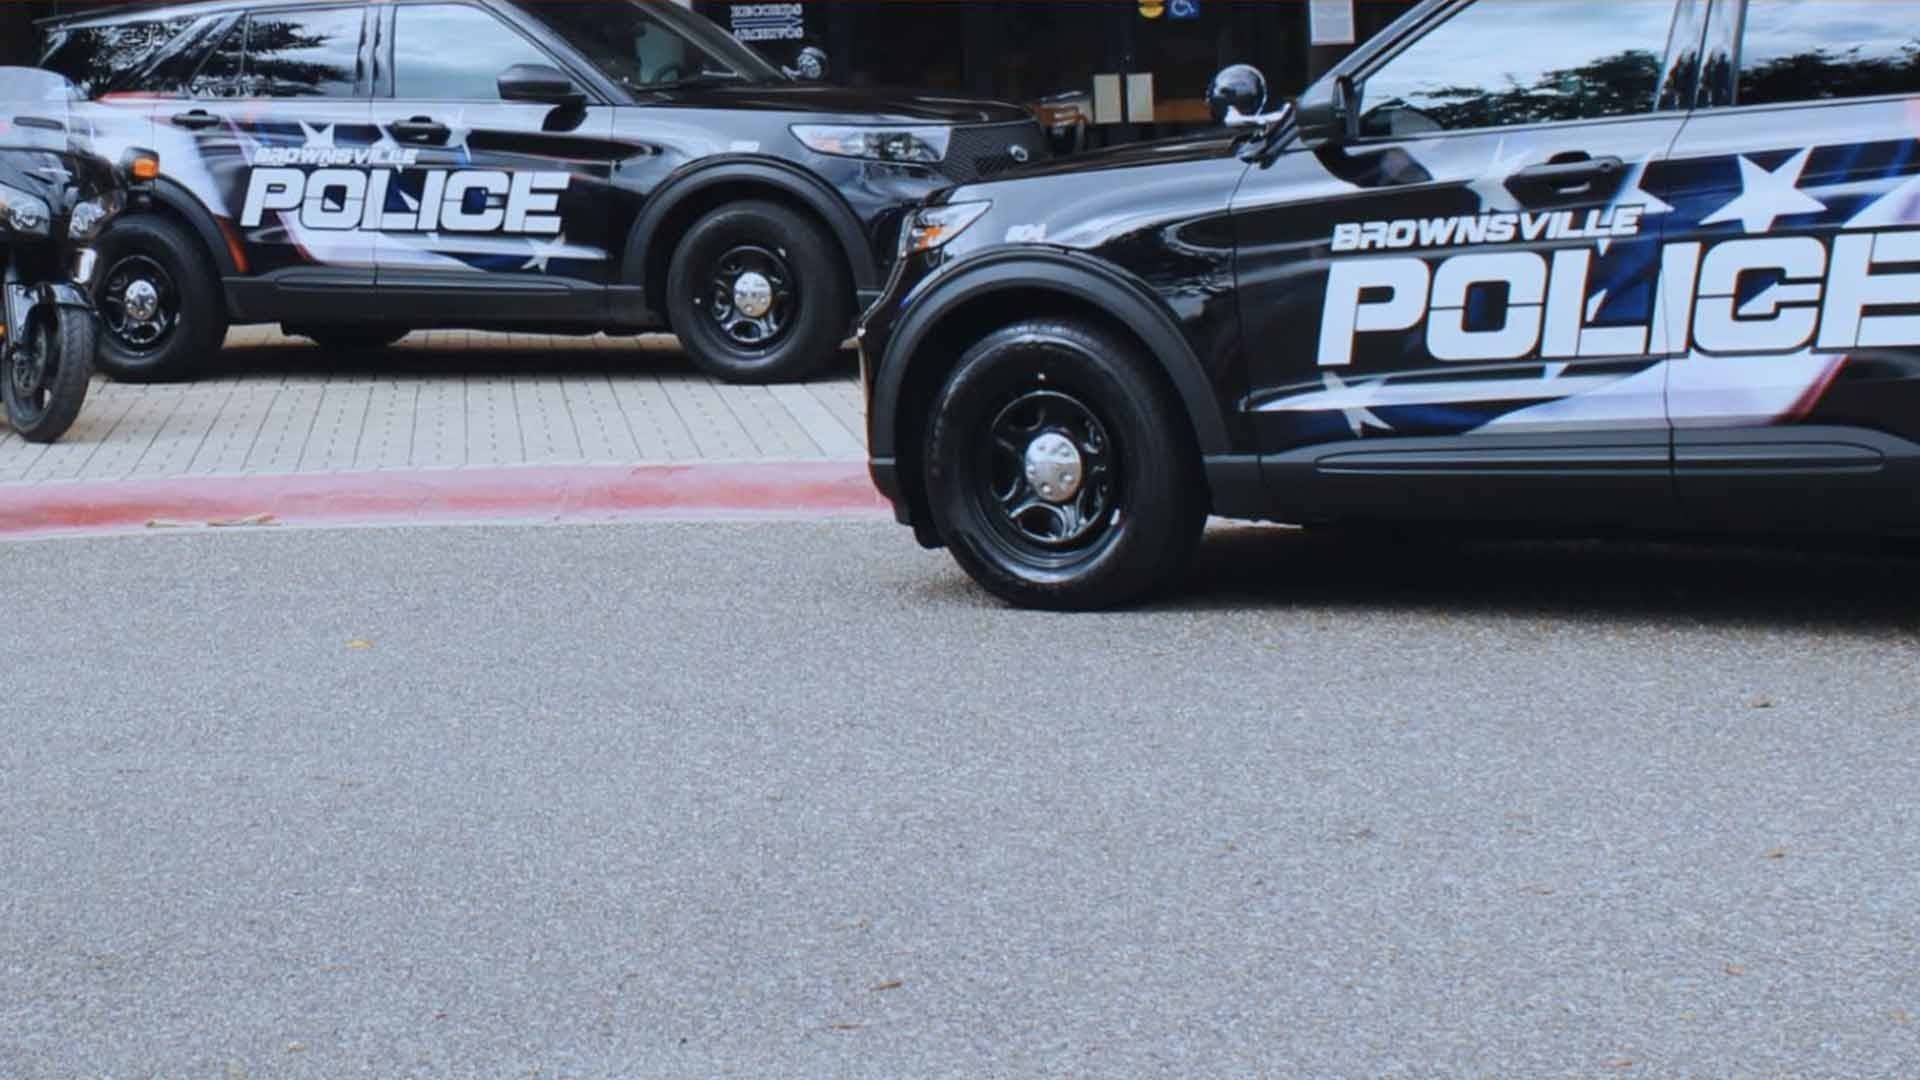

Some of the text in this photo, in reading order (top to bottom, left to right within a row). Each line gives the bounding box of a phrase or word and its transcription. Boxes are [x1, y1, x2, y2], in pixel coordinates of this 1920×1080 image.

[254, 147, 419, 166] BROWNSVILLE
[240, 168, 572, 234] POLICE
[1331, 204, 1645, 251] BROWNSVILLE
[1317, 230, 1920, 366] POLICE
